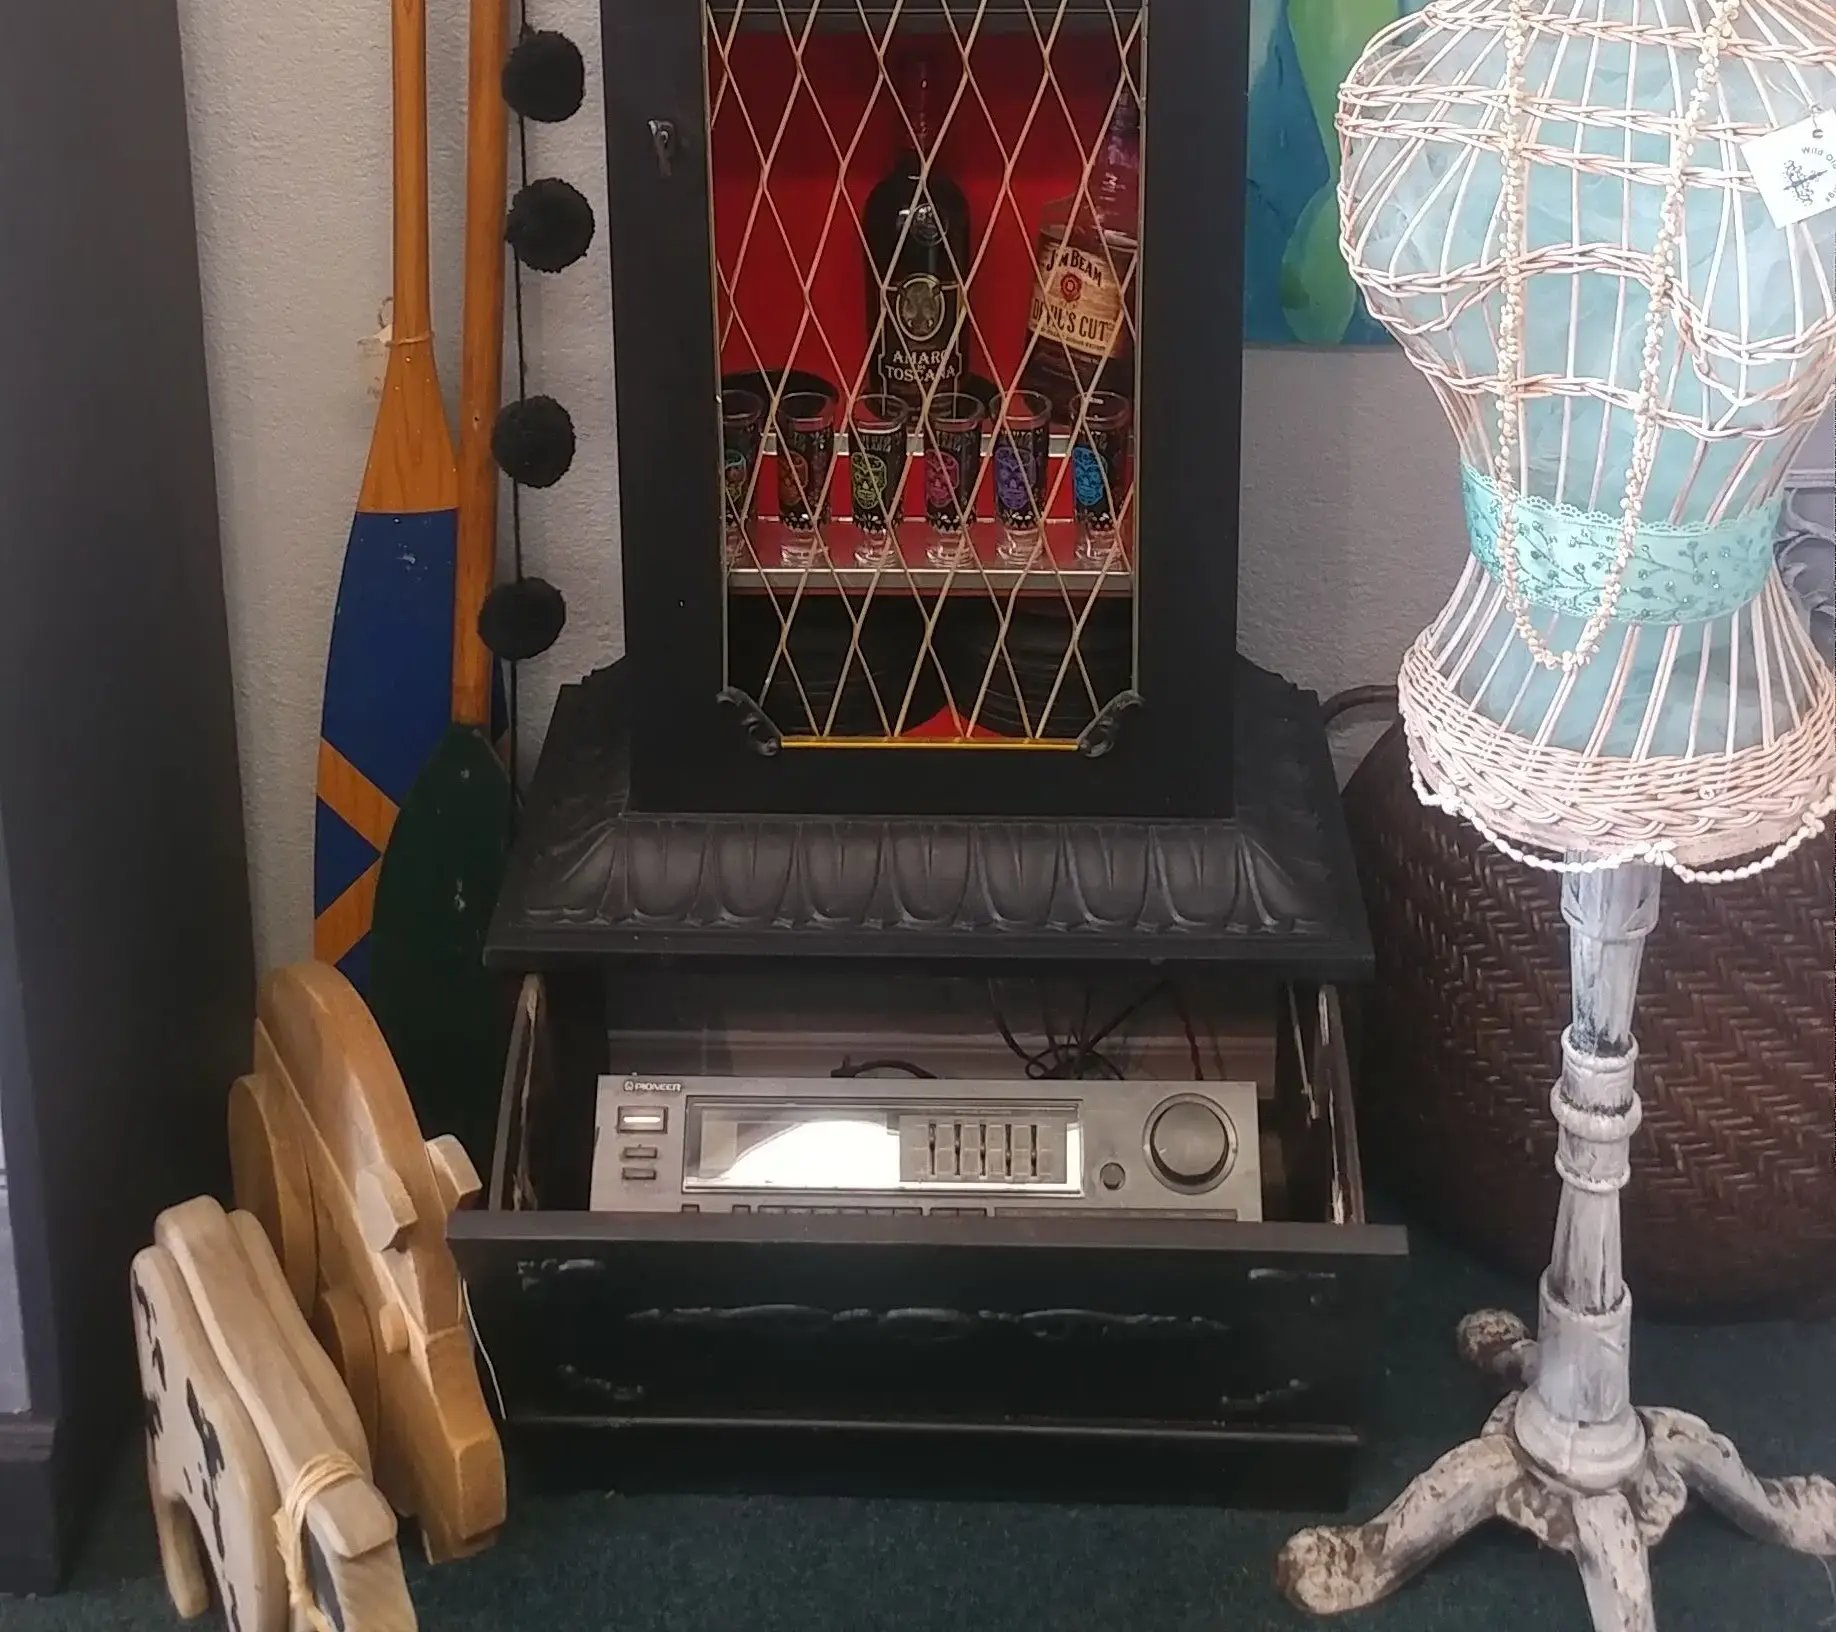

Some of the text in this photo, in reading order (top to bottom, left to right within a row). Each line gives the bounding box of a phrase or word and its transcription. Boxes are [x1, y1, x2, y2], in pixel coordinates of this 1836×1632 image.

[1801, 146, 1824, 156] Wild
[1079, 315, 1109, 342] CUT
[634, 1082, 682, 1092] PIONEER
